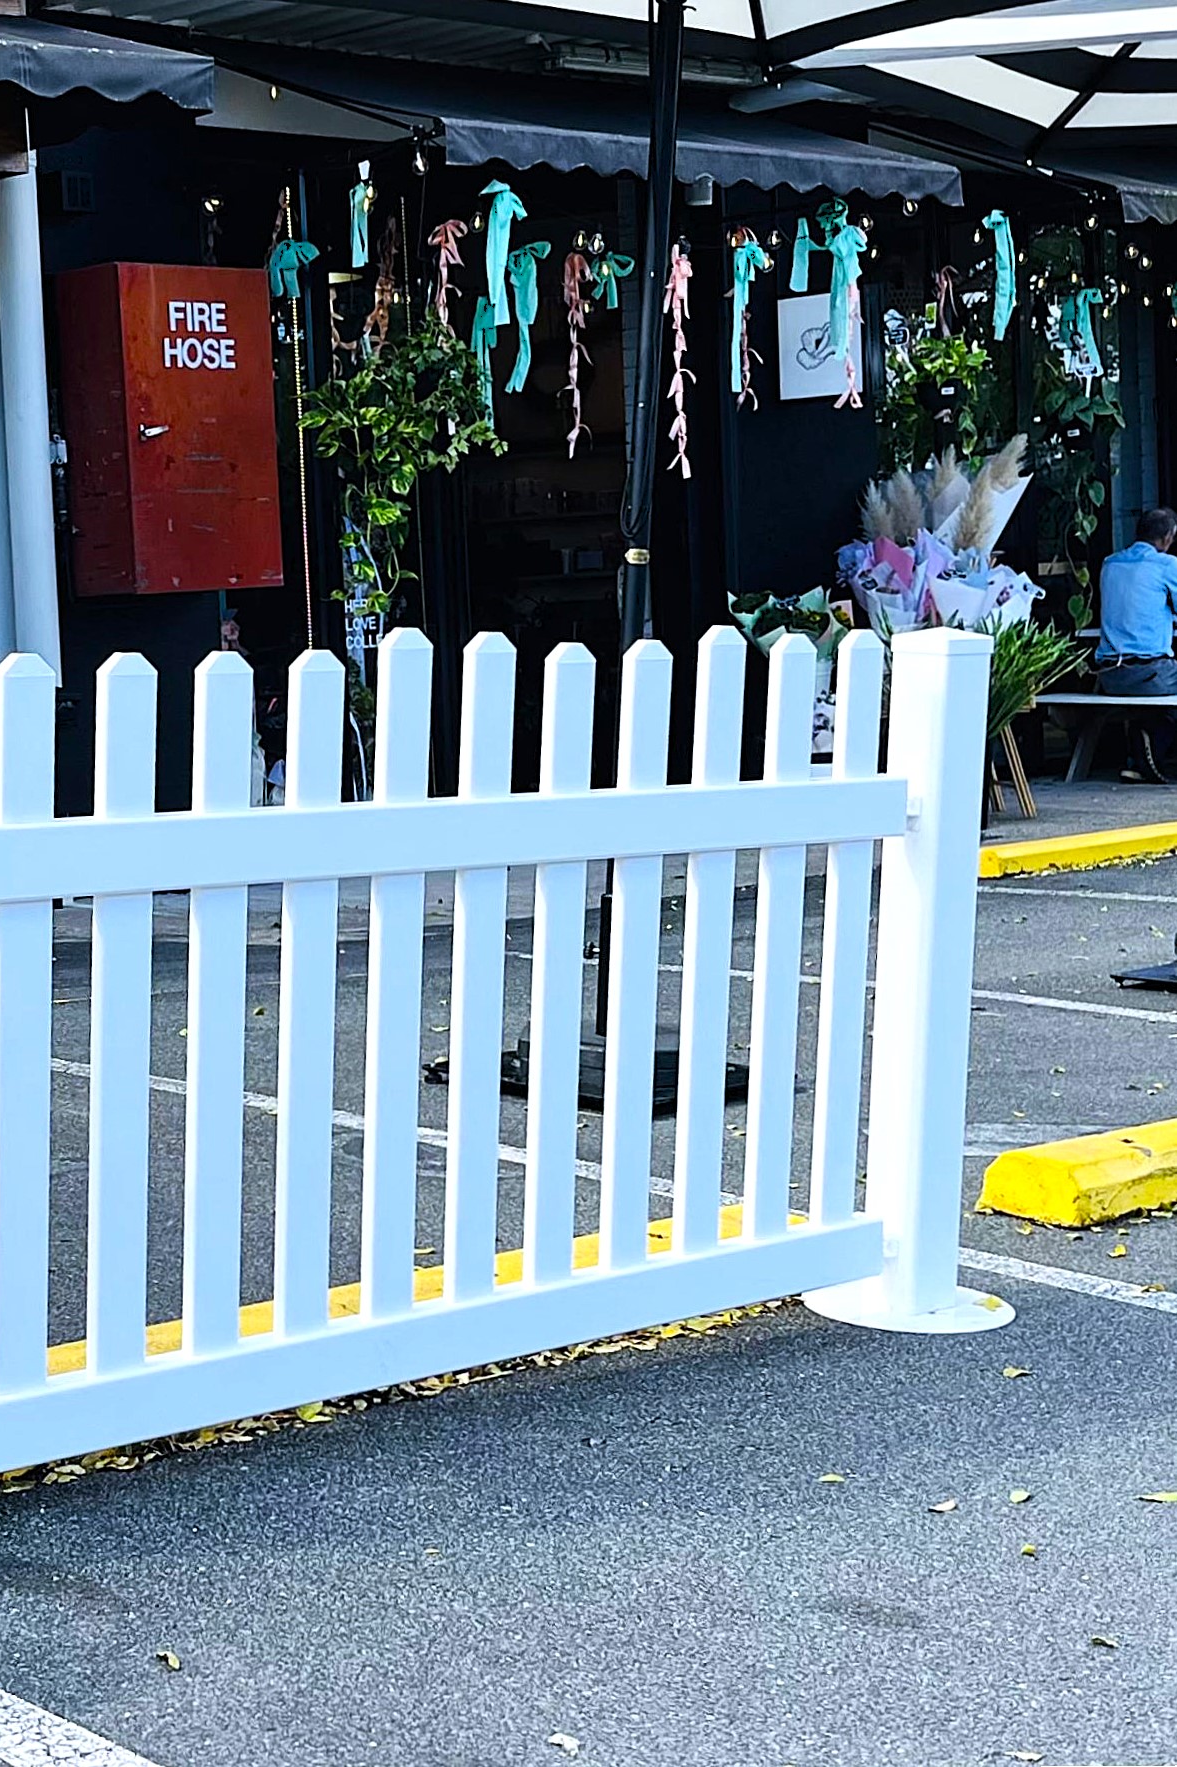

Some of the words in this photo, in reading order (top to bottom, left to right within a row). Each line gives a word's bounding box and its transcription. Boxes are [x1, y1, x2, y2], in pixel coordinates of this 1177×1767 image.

[168, 301, 227, 332] FIRE
[163, 337, 236, 369] HOSE
[345, 616, 377, 631] LOVE
